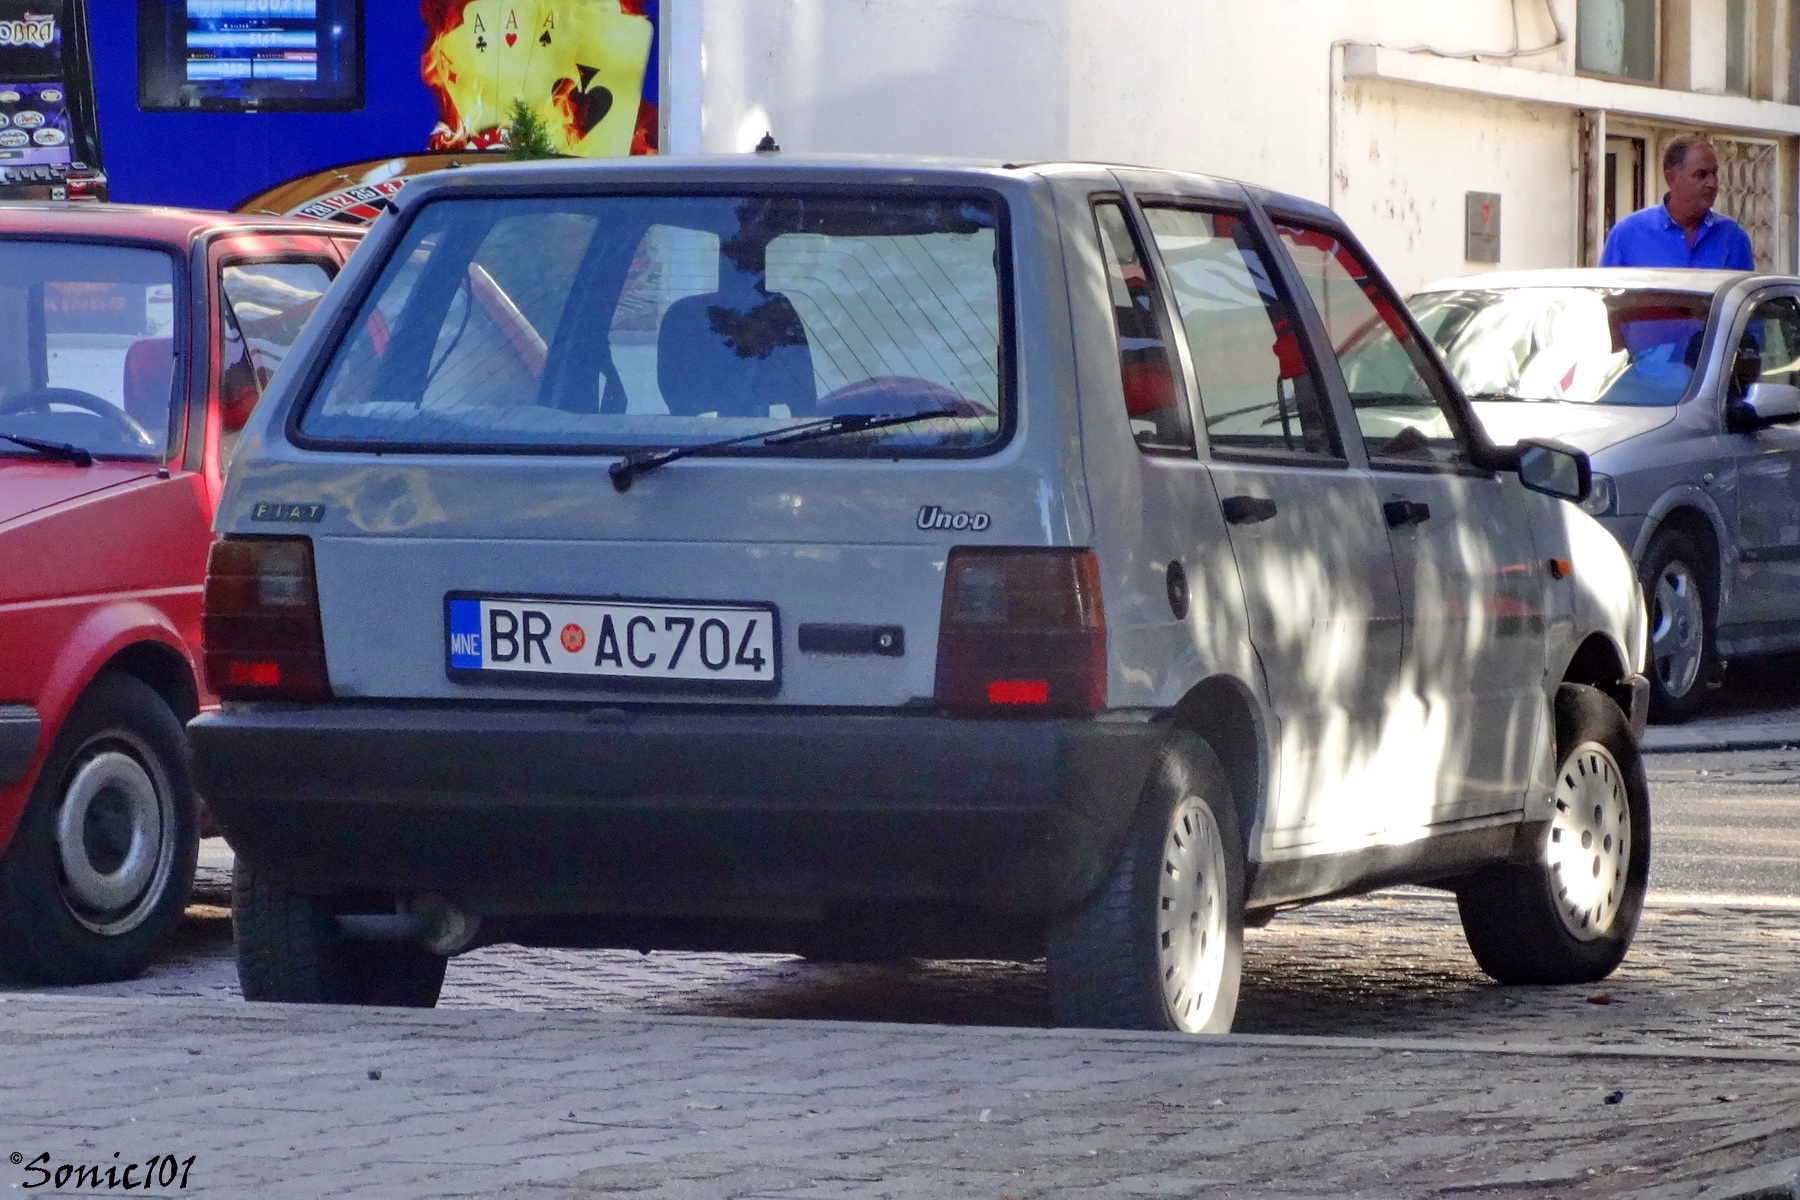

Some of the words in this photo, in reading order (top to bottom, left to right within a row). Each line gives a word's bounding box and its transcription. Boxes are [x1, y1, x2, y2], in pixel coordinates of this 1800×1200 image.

[473, 13, 486, 33] A
[505, 9, 518, 29] A
[543, 10, 555, 29] A
[256, 504, 318, 518] FIAT
[451, 633, 481, 657] MNE
[489, 609, 552, 664] BR
[595, 613, 766, 672] AC704
